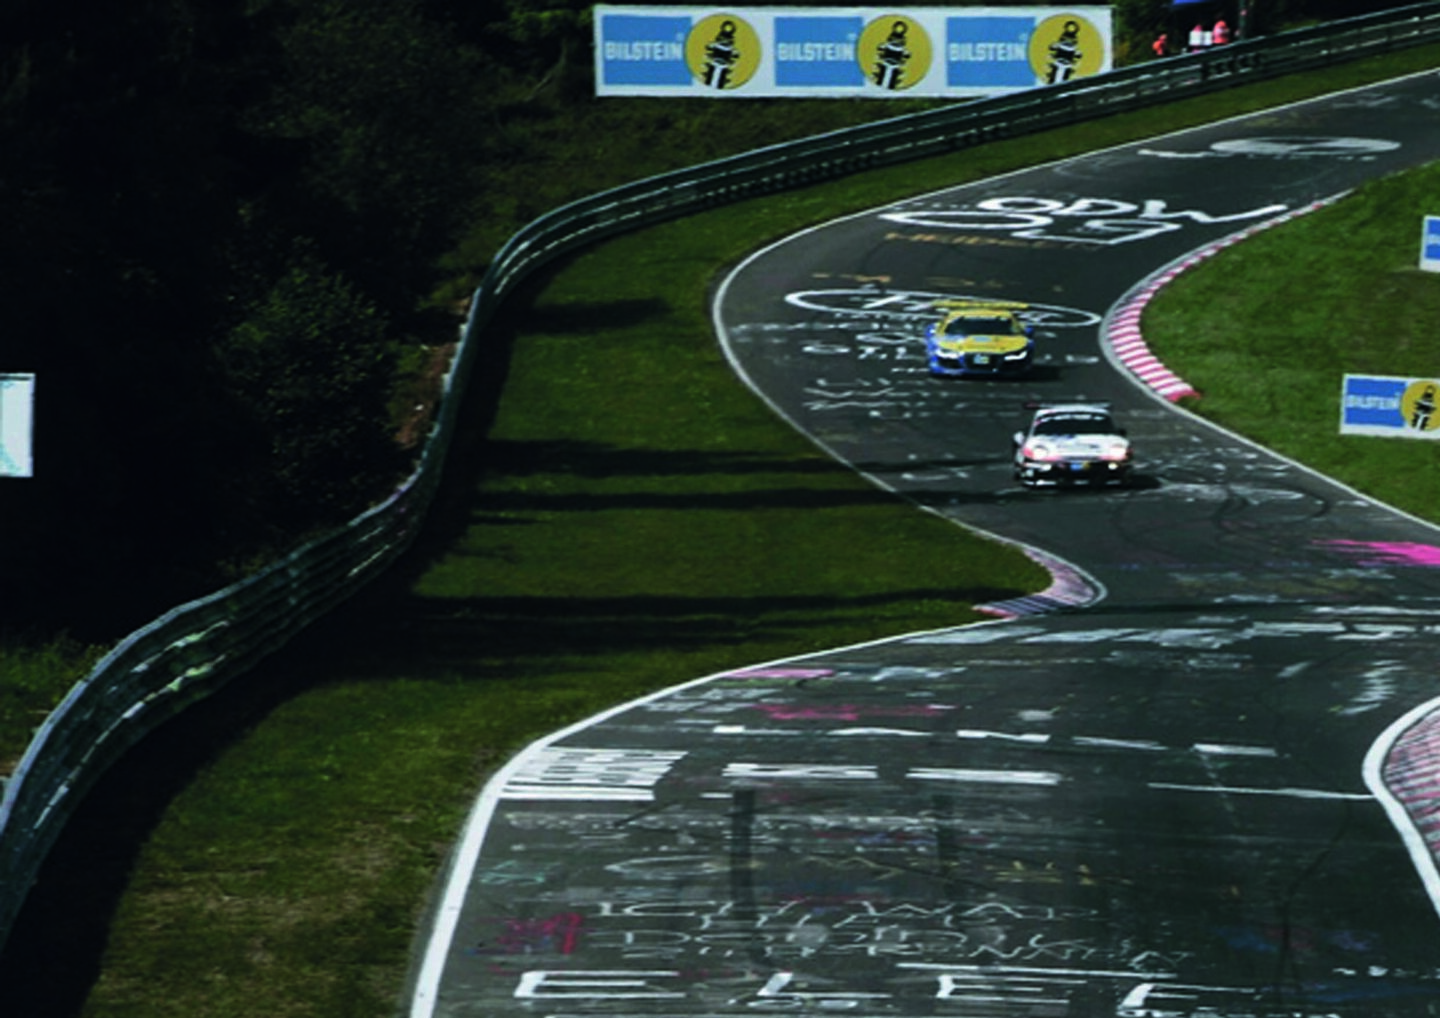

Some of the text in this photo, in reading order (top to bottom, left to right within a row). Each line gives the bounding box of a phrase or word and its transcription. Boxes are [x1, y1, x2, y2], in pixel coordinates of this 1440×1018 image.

[604, 41, 683, 61] BILSTEIN
[777, 42, 855, 61] BILSTEIN
[948, 42, 1027, 61] BILSTEIN
